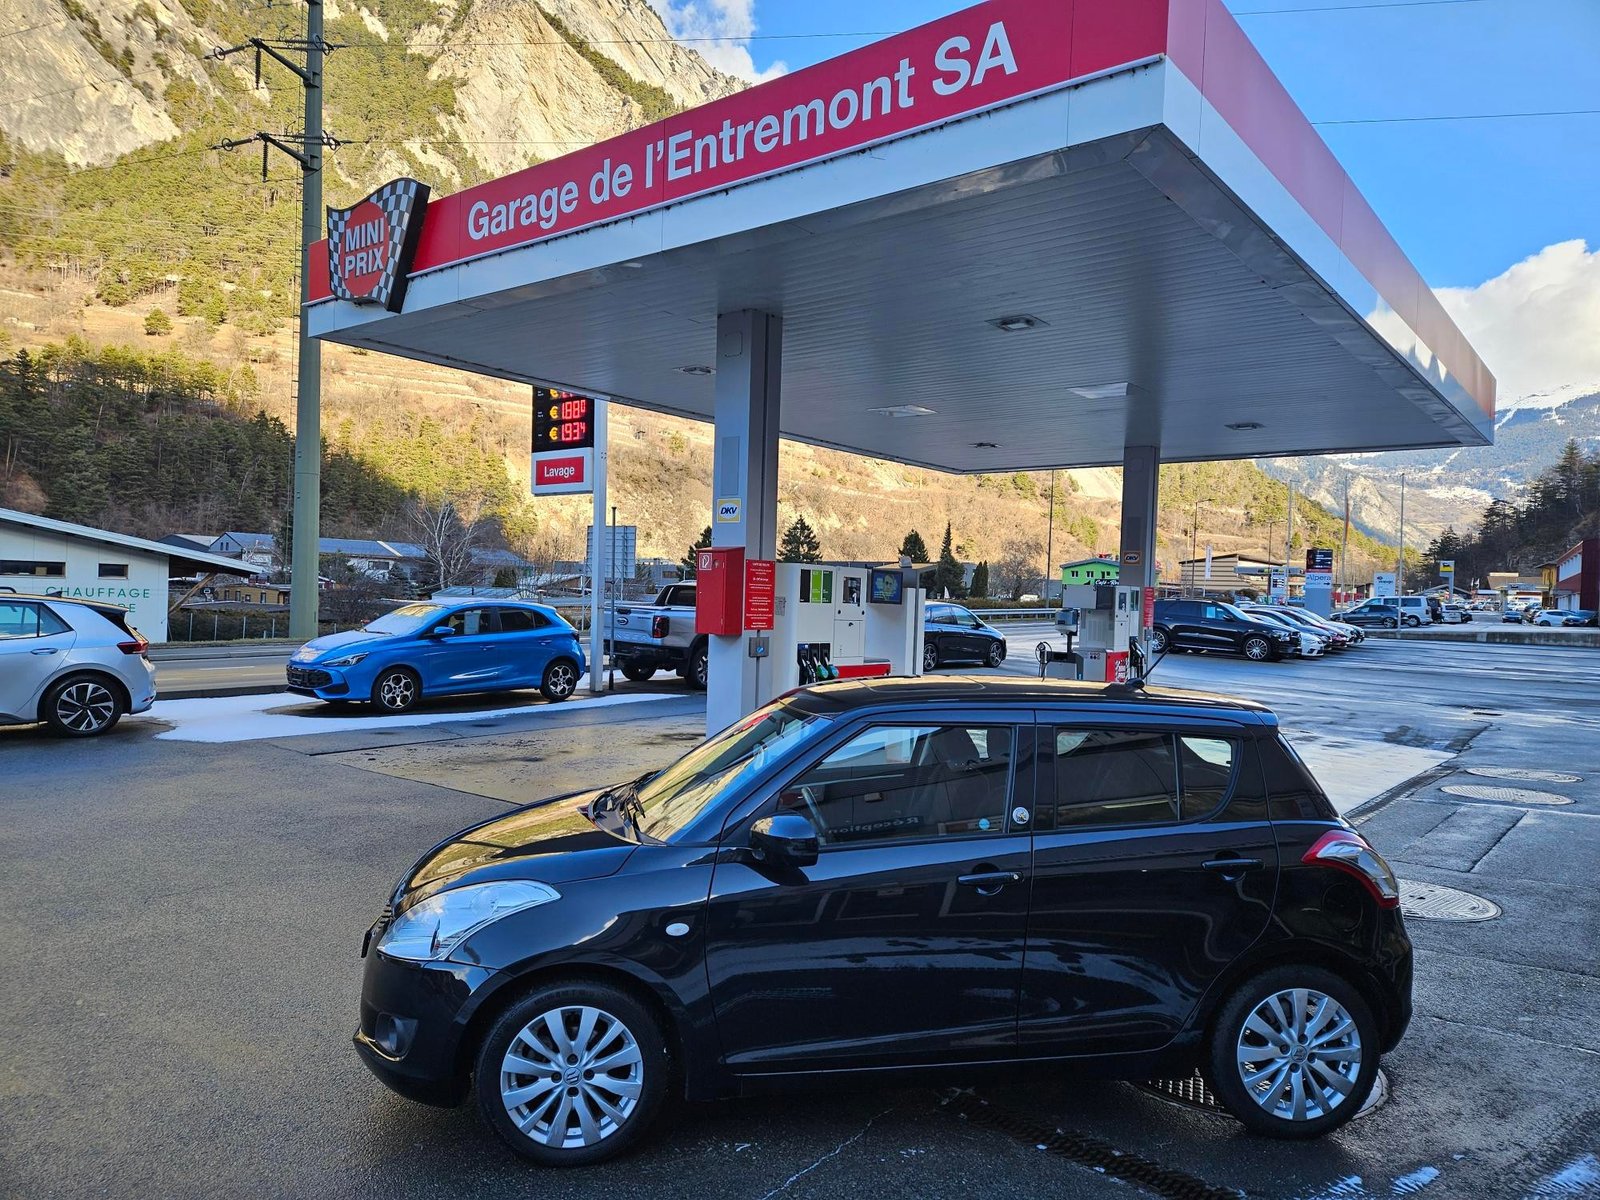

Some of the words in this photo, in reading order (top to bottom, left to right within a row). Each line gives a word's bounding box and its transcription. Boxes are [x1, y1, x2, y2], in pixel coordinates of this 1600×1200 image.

[468, 181, 579, 240] Garage
[589, 158, 633, 205] de
[645, 57, 915, 189] l'Entremont
[932, 21, 1018, 96] SA
[345, 217, 385, 253] MINI
[344, 246, 385, 279] PRIX
[544, 465, 575, 478] Lavage
[720, 506, 738, 515] DKV
[45, 586, 151, 599] CHAUFFAGE
